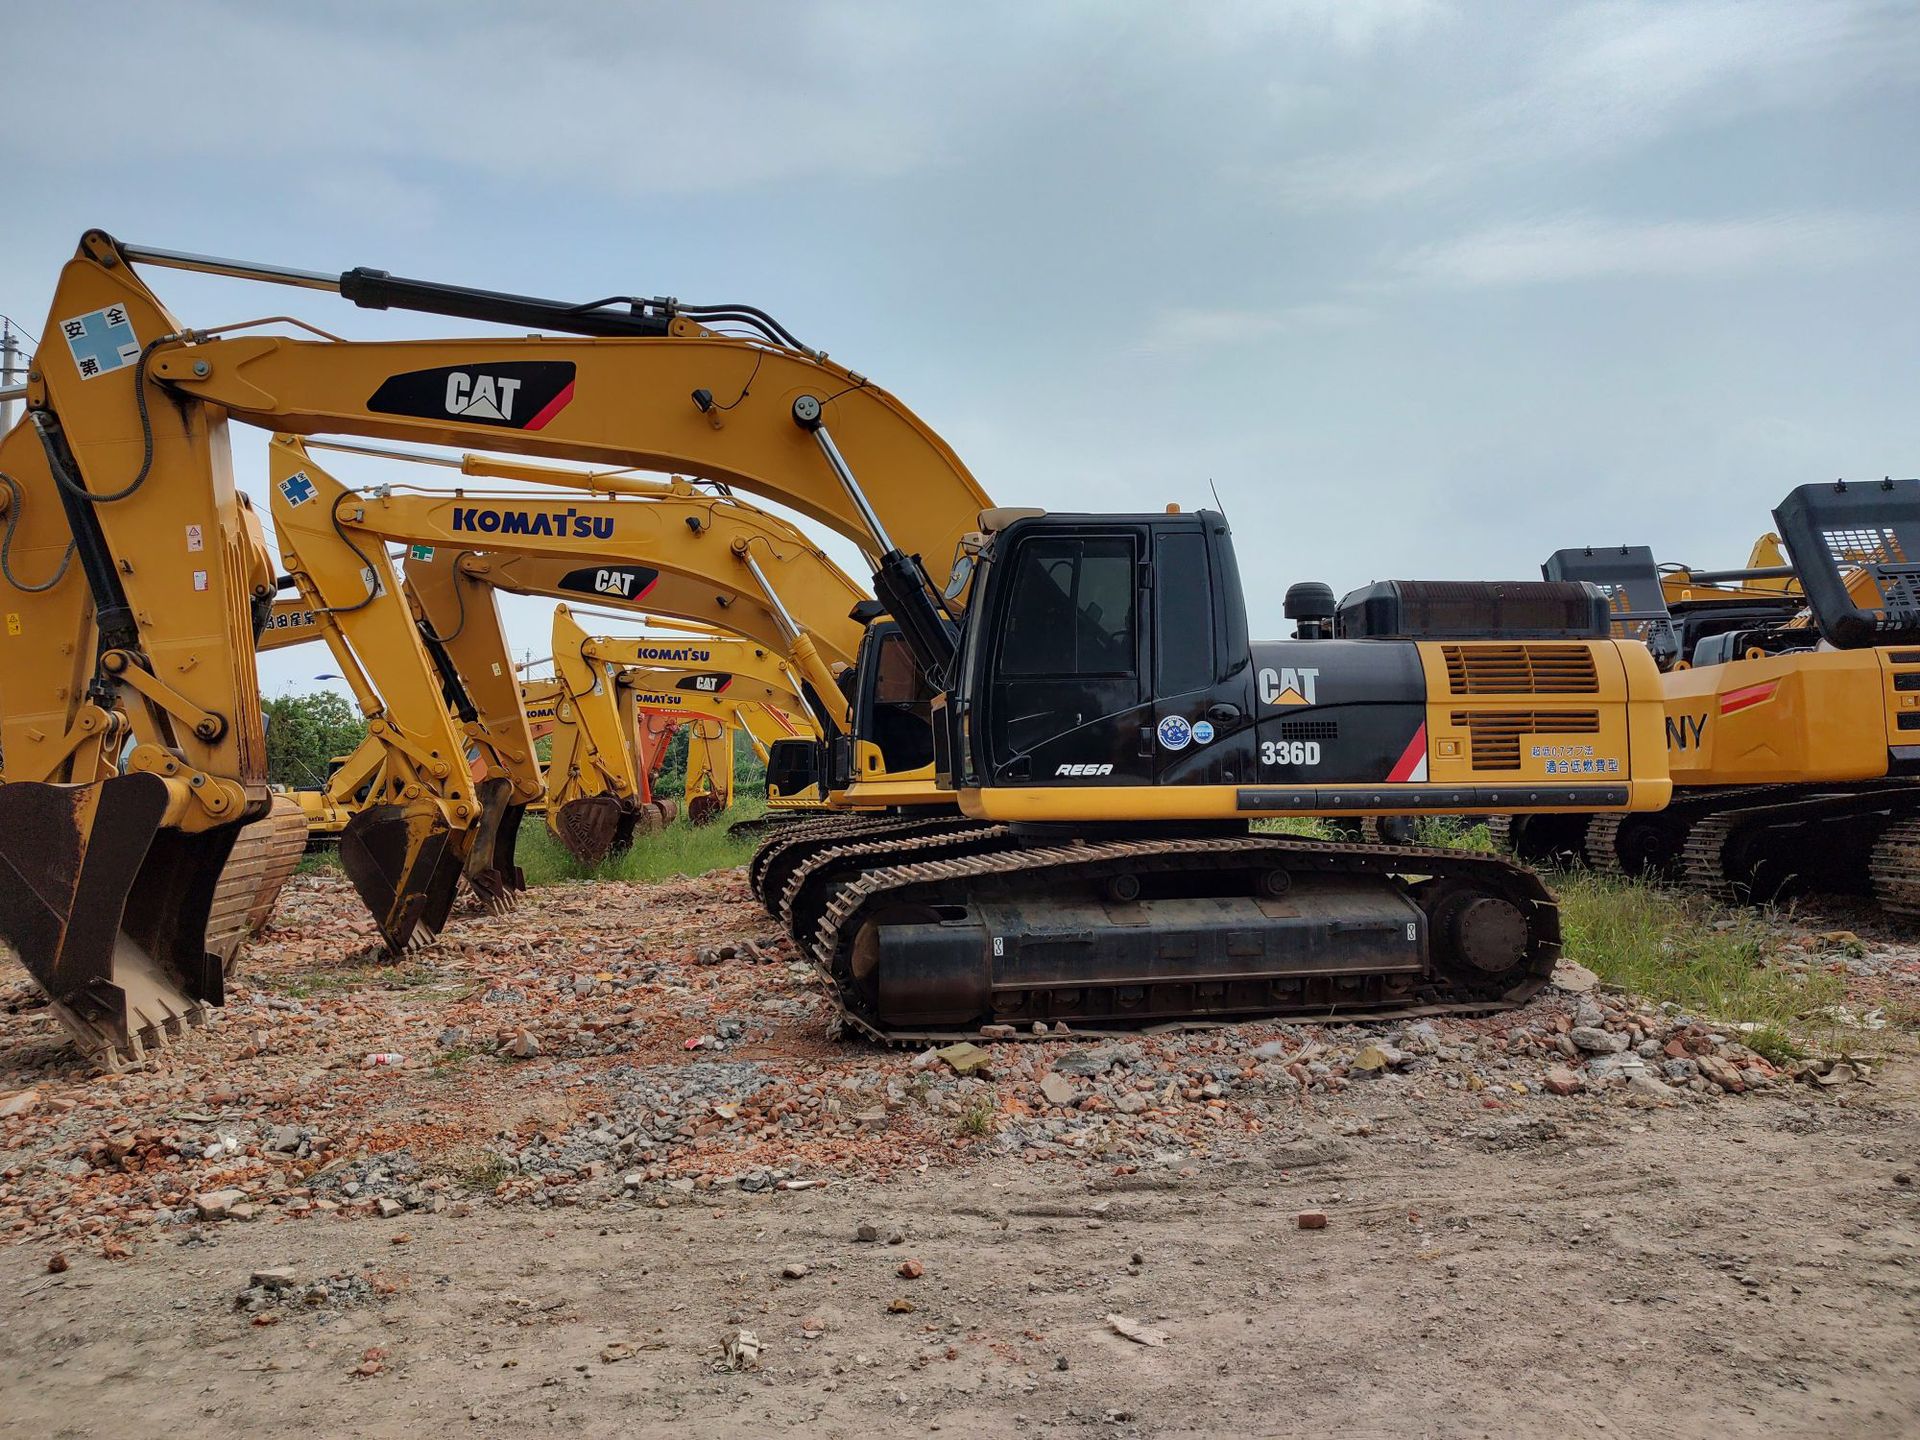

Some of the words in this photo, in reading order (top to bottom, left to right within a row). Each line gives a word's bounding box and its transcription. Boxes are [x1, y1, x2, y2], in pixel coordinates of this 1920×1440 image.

[445, 371, 521, 420] CAT
[452, 507, 614, 539] KOMATSU
[594, 569, 635, 596] CAT
[637, 648, 710, 662] KOMATSU
[696, 677, 717, 691] CAT
[1258, 667, 1320, 705] CAT
[1664, 713, 1708, 751] NY
[1261, 741, 1320, 765] 336D
[1054, 763, 1113, 776] REGA
